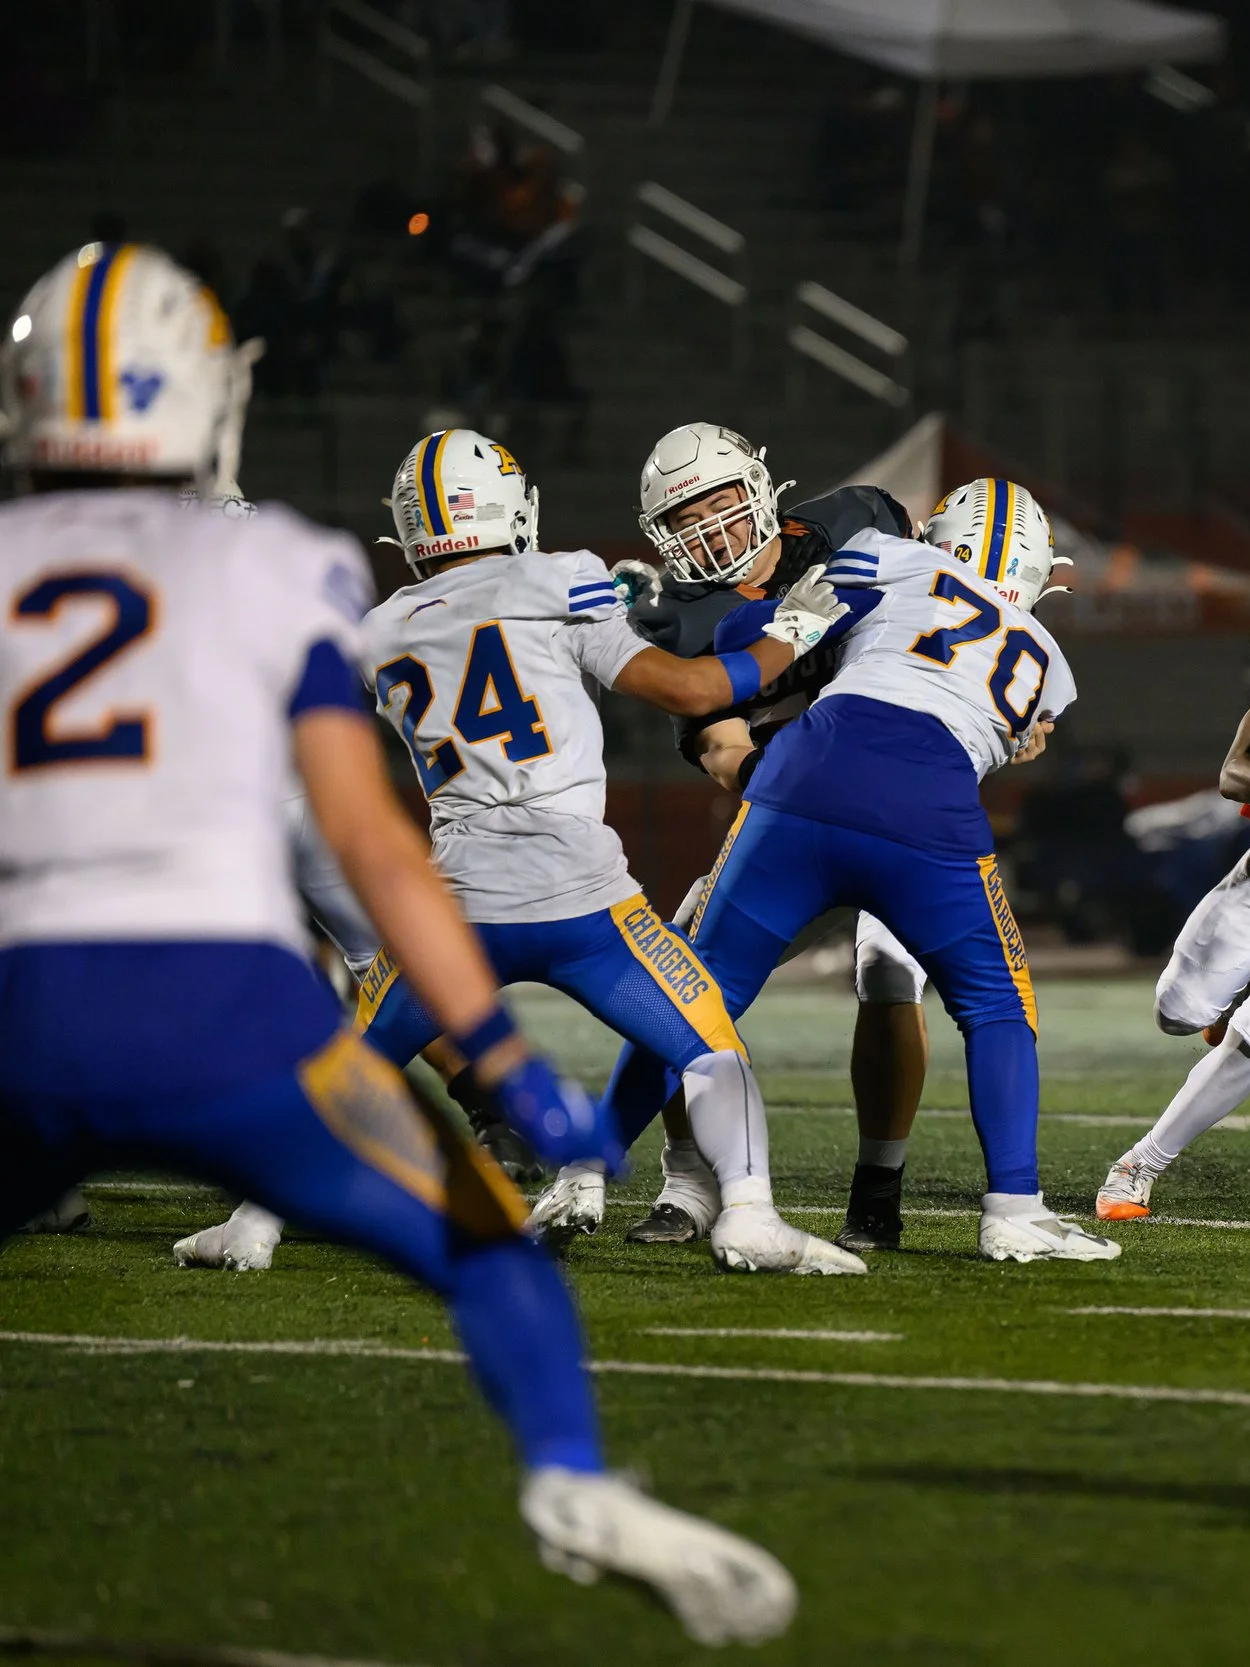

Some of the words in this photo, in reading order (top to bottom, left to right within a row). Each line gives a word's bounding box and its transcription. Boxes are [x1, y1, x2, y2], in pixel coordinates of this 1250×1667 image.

[668, 475, 701, 495] Riddell
[415, 535, 479, 558] Riddell
[10, 567, 156, 772] 2
[906, 568, 1050, 742] 70
[374, 618, 555, 802] 24
[623, 906, 710, 1006] CHARGERS
[986, 865, 1027, 973] CHARGERS
